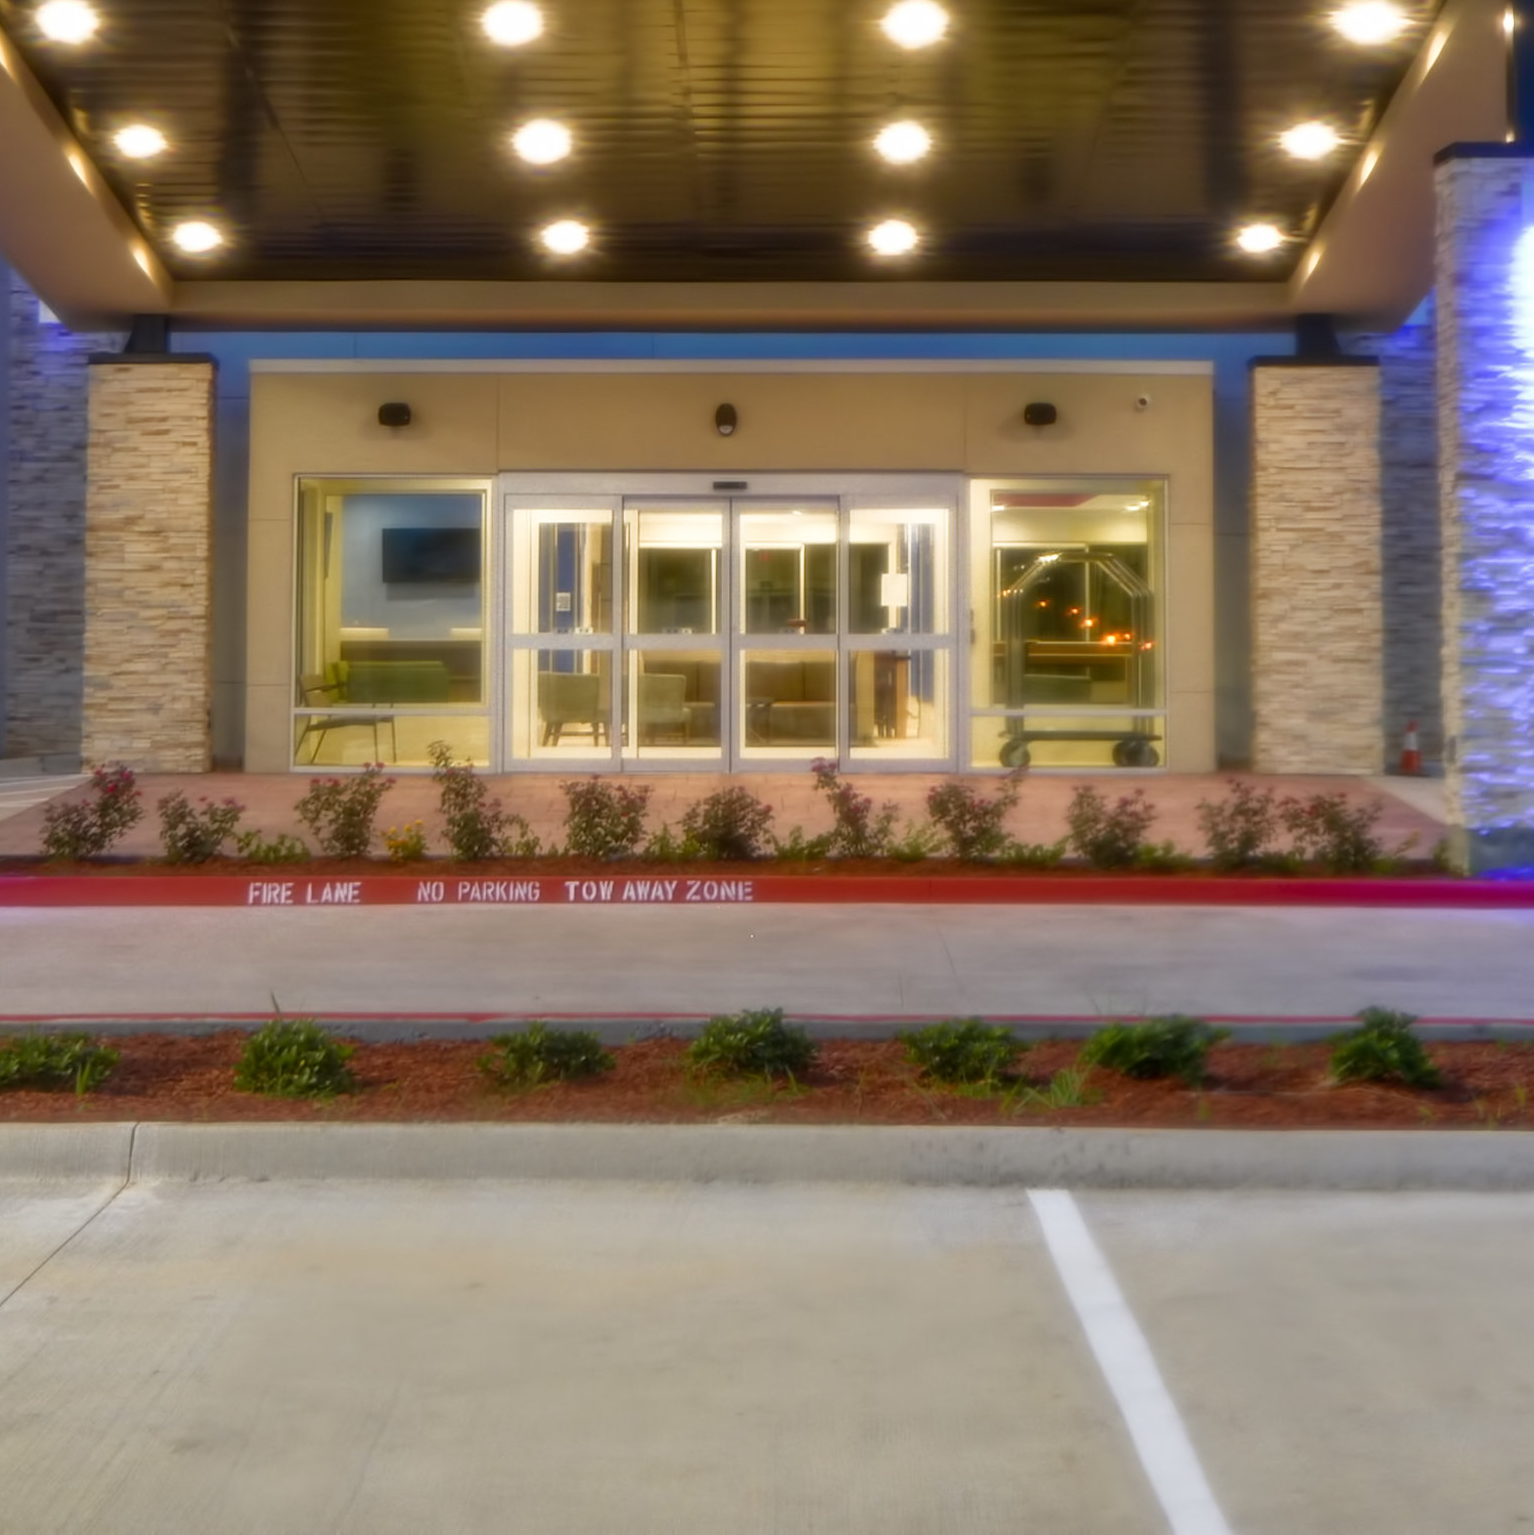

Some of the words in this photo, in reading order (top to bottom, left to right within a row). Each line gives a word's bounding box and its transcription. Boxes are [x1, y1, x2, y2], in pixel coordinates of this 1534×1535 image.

[248, 882, 294, 904] FIRE
[306, 882, 363, 904] LANE
[417, 881, 444, 902] NO
[458, 881, 540, 902] PARKING
[565, 880, 614, 901] TOW
[622, 880, 678, 901] AWAY
[686, 880, 753, 901] ZONE
